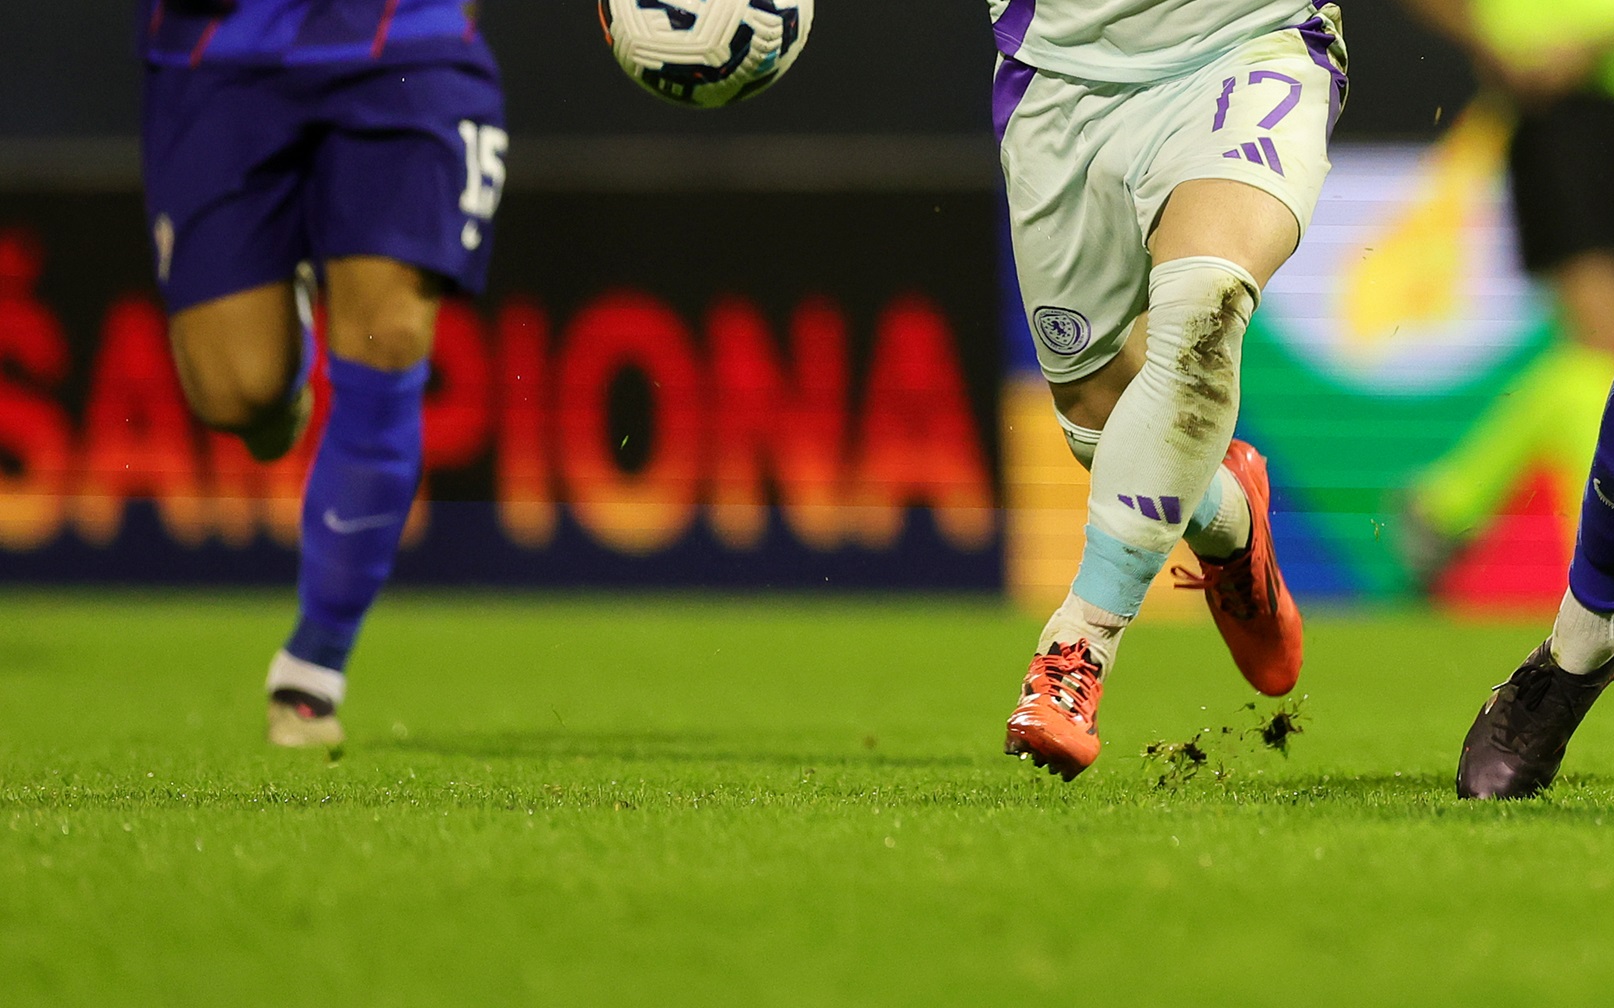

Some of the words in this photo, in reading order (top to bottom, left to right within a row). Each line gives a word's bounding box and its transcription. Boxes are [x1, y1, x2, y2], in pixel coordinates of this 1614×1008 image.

[1212, 70, 1302, 132] 17
[458, 119, 509, 220] 15
[0, 220, 998, 552] ŠAPIONA
